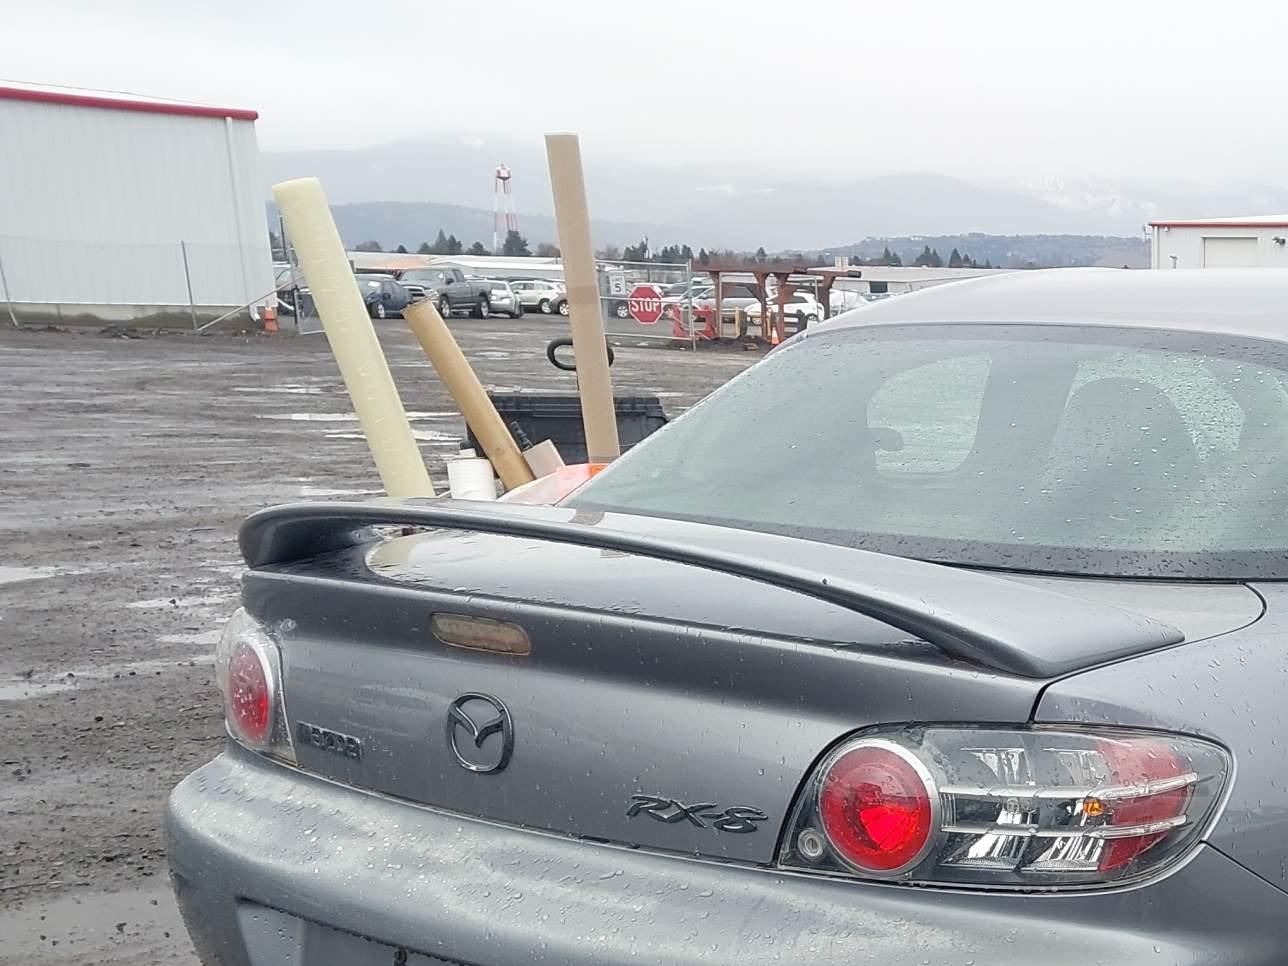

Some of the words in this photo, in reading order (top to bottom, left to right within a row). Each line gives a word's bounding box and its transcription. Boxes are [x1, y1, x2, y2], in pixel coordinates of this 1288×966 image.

[615, 283, 622, 292] 5
[631, 297, 660, 312] STOP
[625, 793, 769, 833] RX-8
